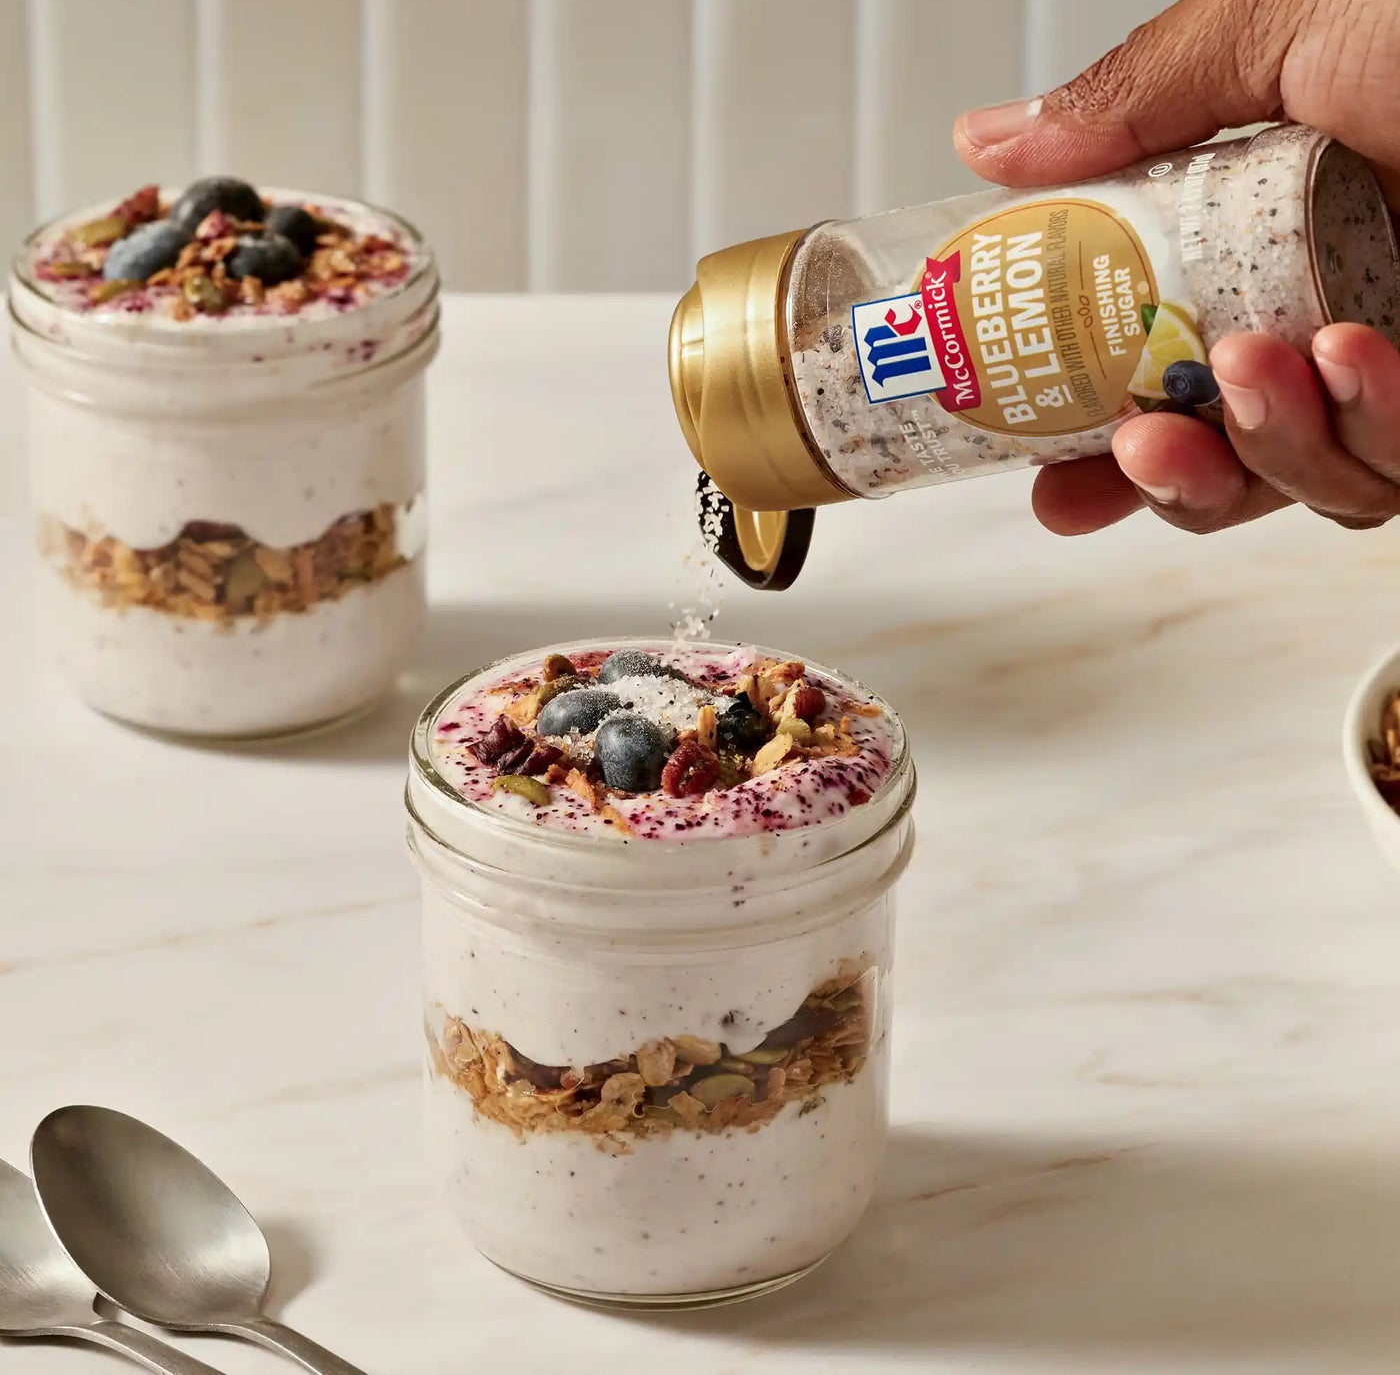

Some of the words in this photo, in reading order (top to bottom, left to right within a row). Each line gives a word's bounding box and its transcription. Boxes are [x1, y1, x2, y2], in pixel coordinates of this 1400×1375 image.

[1046, 208, 1070, 252] FLAVORS
[1181, 237, 1203, 262] NET
[1046, 252, 1070, 304] NATURAL
[1006, 231, 1062, 378] LEMON
[1051, 305, 1078, 342] OTHER
[1093, 253, 1127, 357] FINISHING
[1114, 266, 1142, 337] SUGAR
[971, 233, 1038, 425] BLUEBERRY
[1060, 341, 1086, 372] WITH
[1035, 385, 1065, 408] &
[1070, 373, 1107, 418] FLAVORED
[899, 422, 935, 466] TASTE
